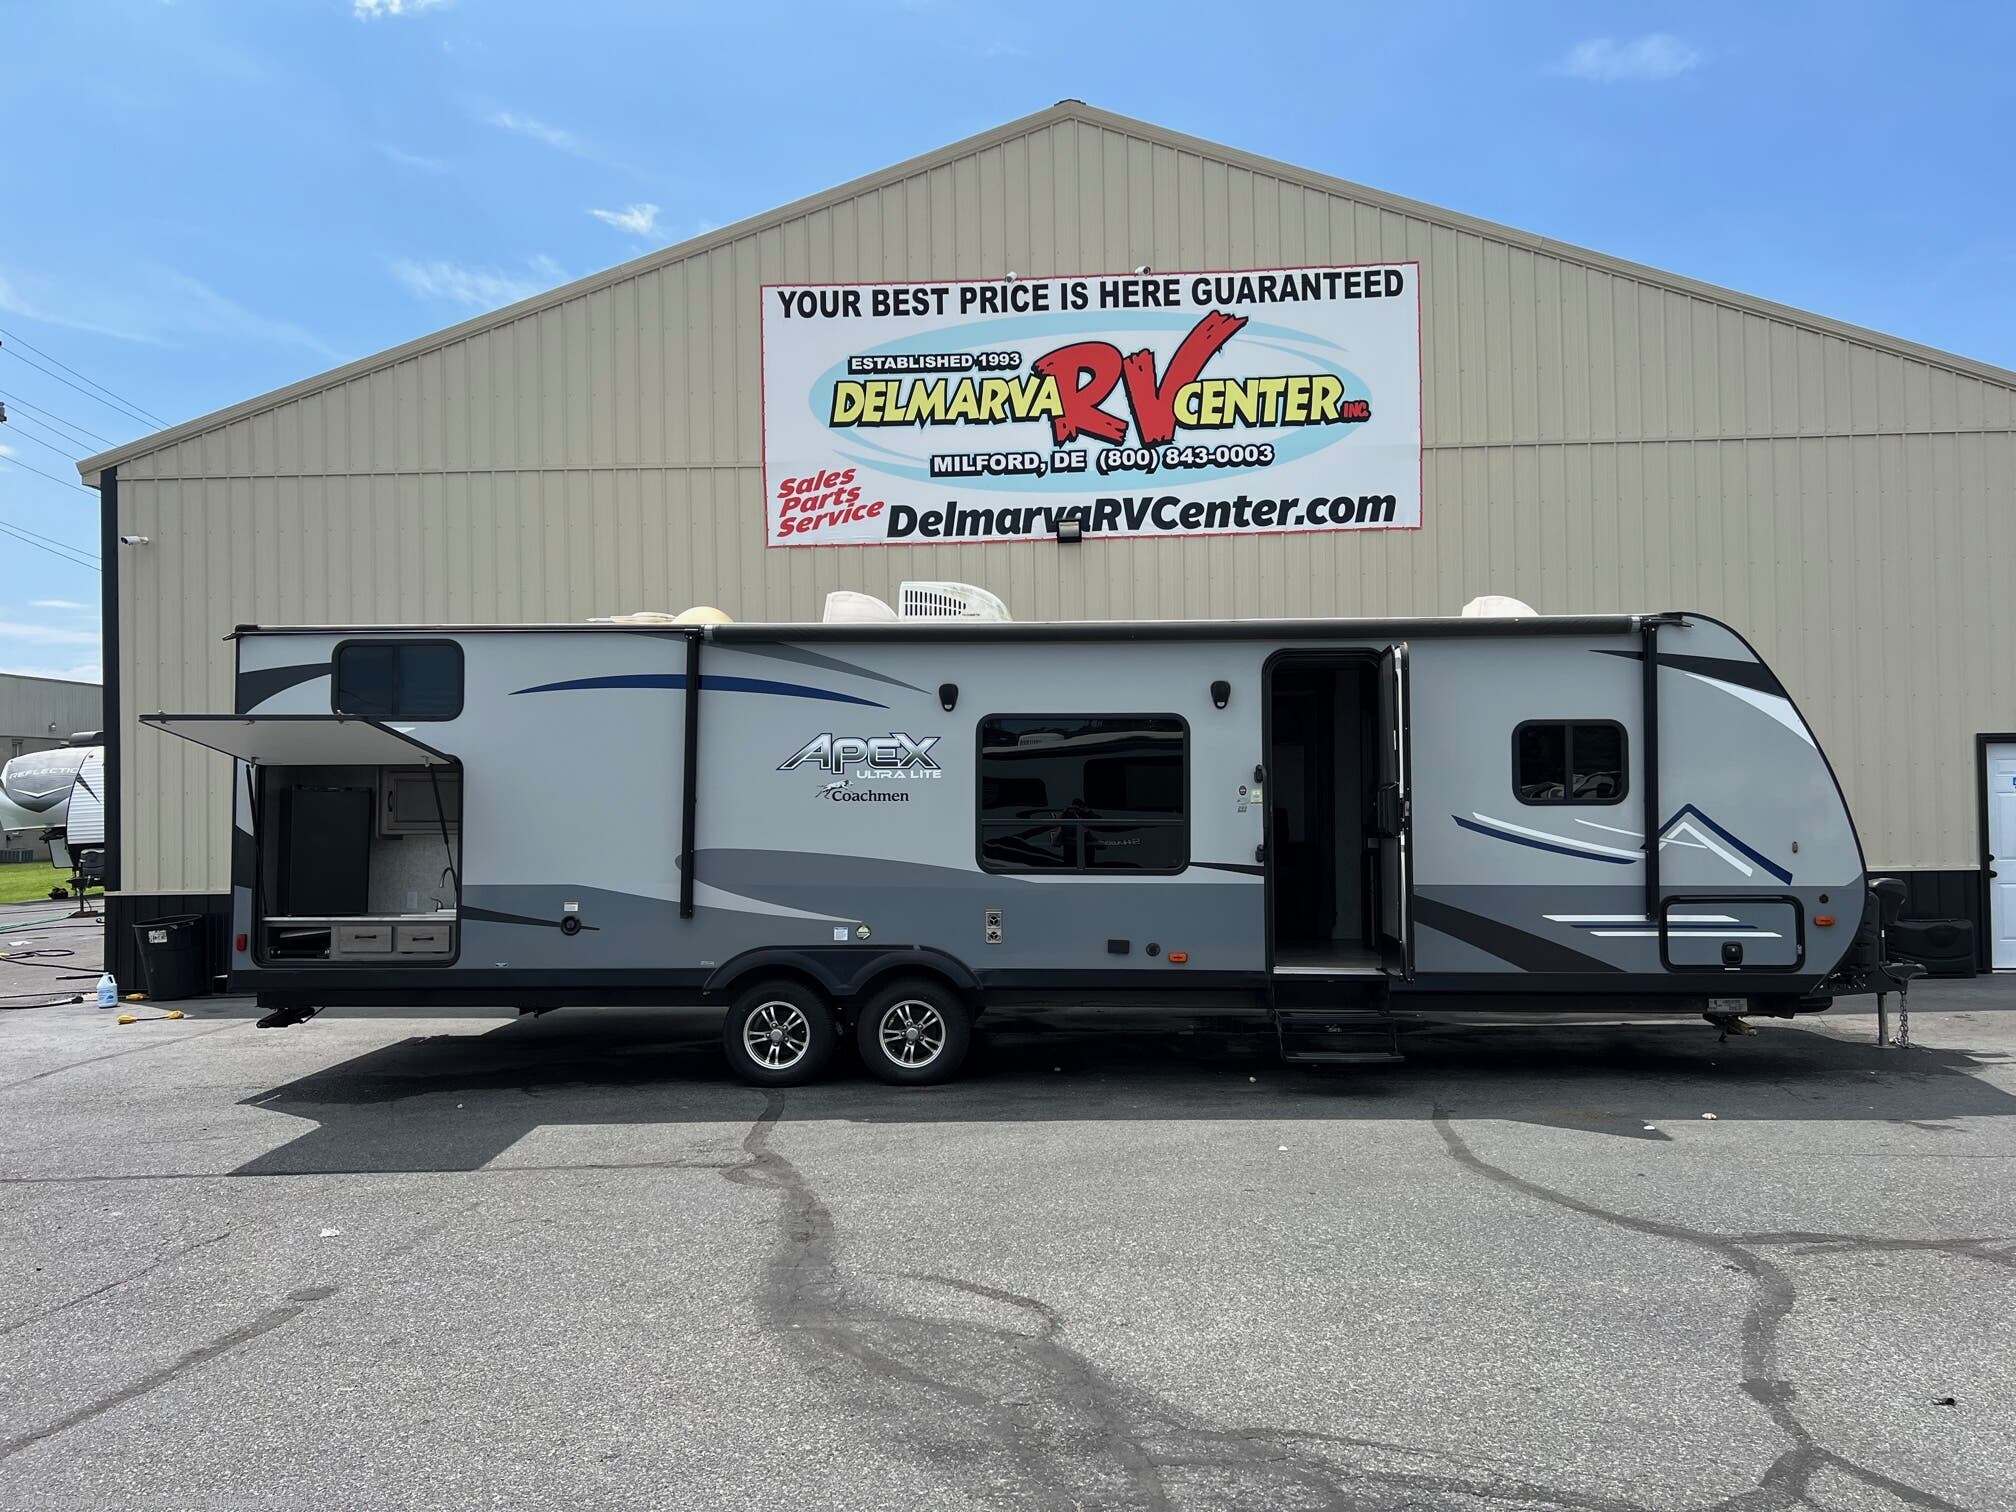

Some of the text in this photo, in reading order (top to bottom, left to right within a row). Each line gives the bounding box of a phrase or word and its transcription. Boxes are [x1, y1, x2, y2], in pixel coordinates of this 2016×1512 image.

[778, 269, 1404, 319] YOUR BEST PRICE IS HERE GUARANTEED
[850, 352, 1021, 371] ESTABLISHED 1993
[830, 375, 1065, 427] DELMARVA
[1031, 310, 1248, 446] RV
[1173, 376, 1344, 428] CENTER
[933, 445, 1274, 472] MILFORD, DE (800) 843-0003
[777, 468, 856, 498] Sales
[779, 487, 861, 518] Parts
[887, 494, 1396, 537] DelmarvaRVCenter.com
[777, 501, 885, 537] Service
[776, 733, 942, 775] APEX
[856, 769, 942, 779] ULTRA LITE
[831, 789, 910, 802] Coachmen
